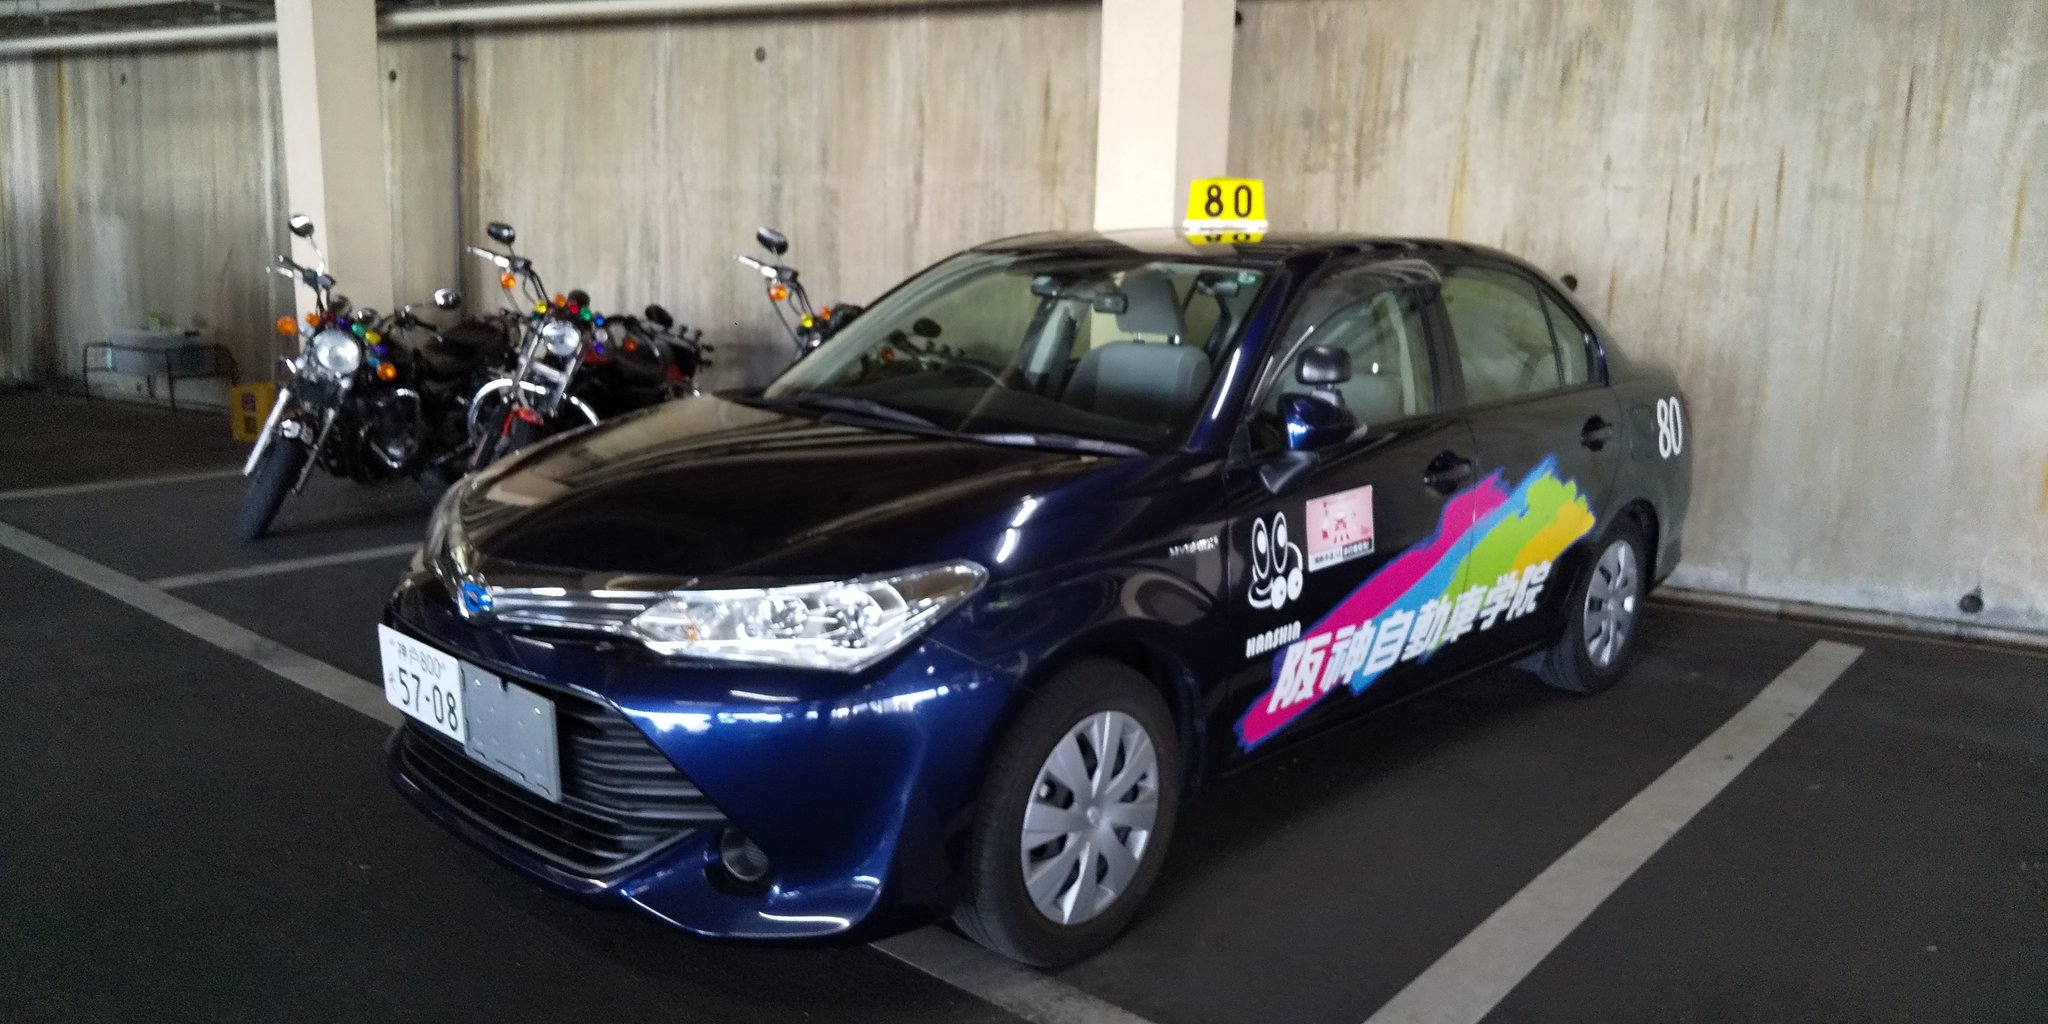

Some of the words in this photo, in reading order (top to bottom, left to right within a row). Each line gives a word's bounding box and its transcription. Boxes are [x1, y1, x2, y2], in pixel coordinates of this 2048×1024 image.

[1204, 184, 1252, 218] 80
[1656, 396, 1683, 459] 80
[1246, 620, 1301, 659] HANSHIN
[1266, 560, 1552, 714] 阪神自動車学院
